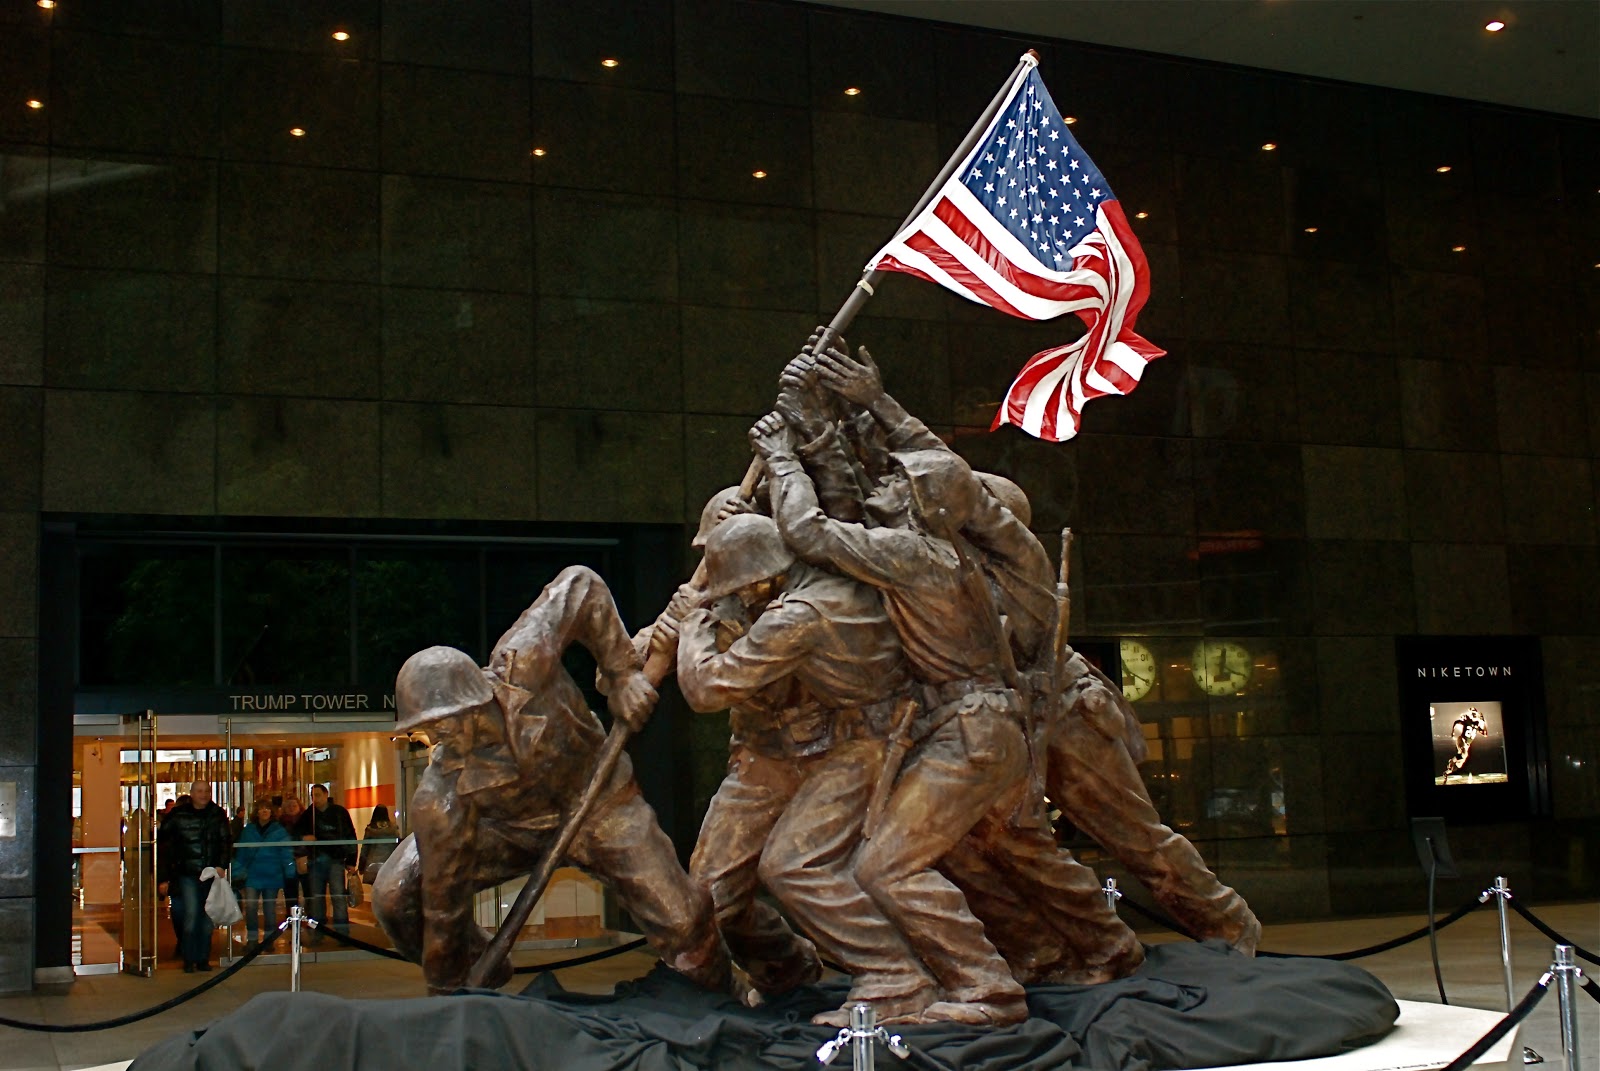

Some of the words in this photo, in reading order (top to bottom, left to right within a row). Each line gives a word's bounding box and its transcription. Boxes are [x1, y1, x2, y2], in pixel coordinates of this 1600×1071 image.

[1417, 666, 1512, 678] NIKETOWN
[230, 695, 296, 710] TRUMP
[301, 694, 369, 709] TOWER
